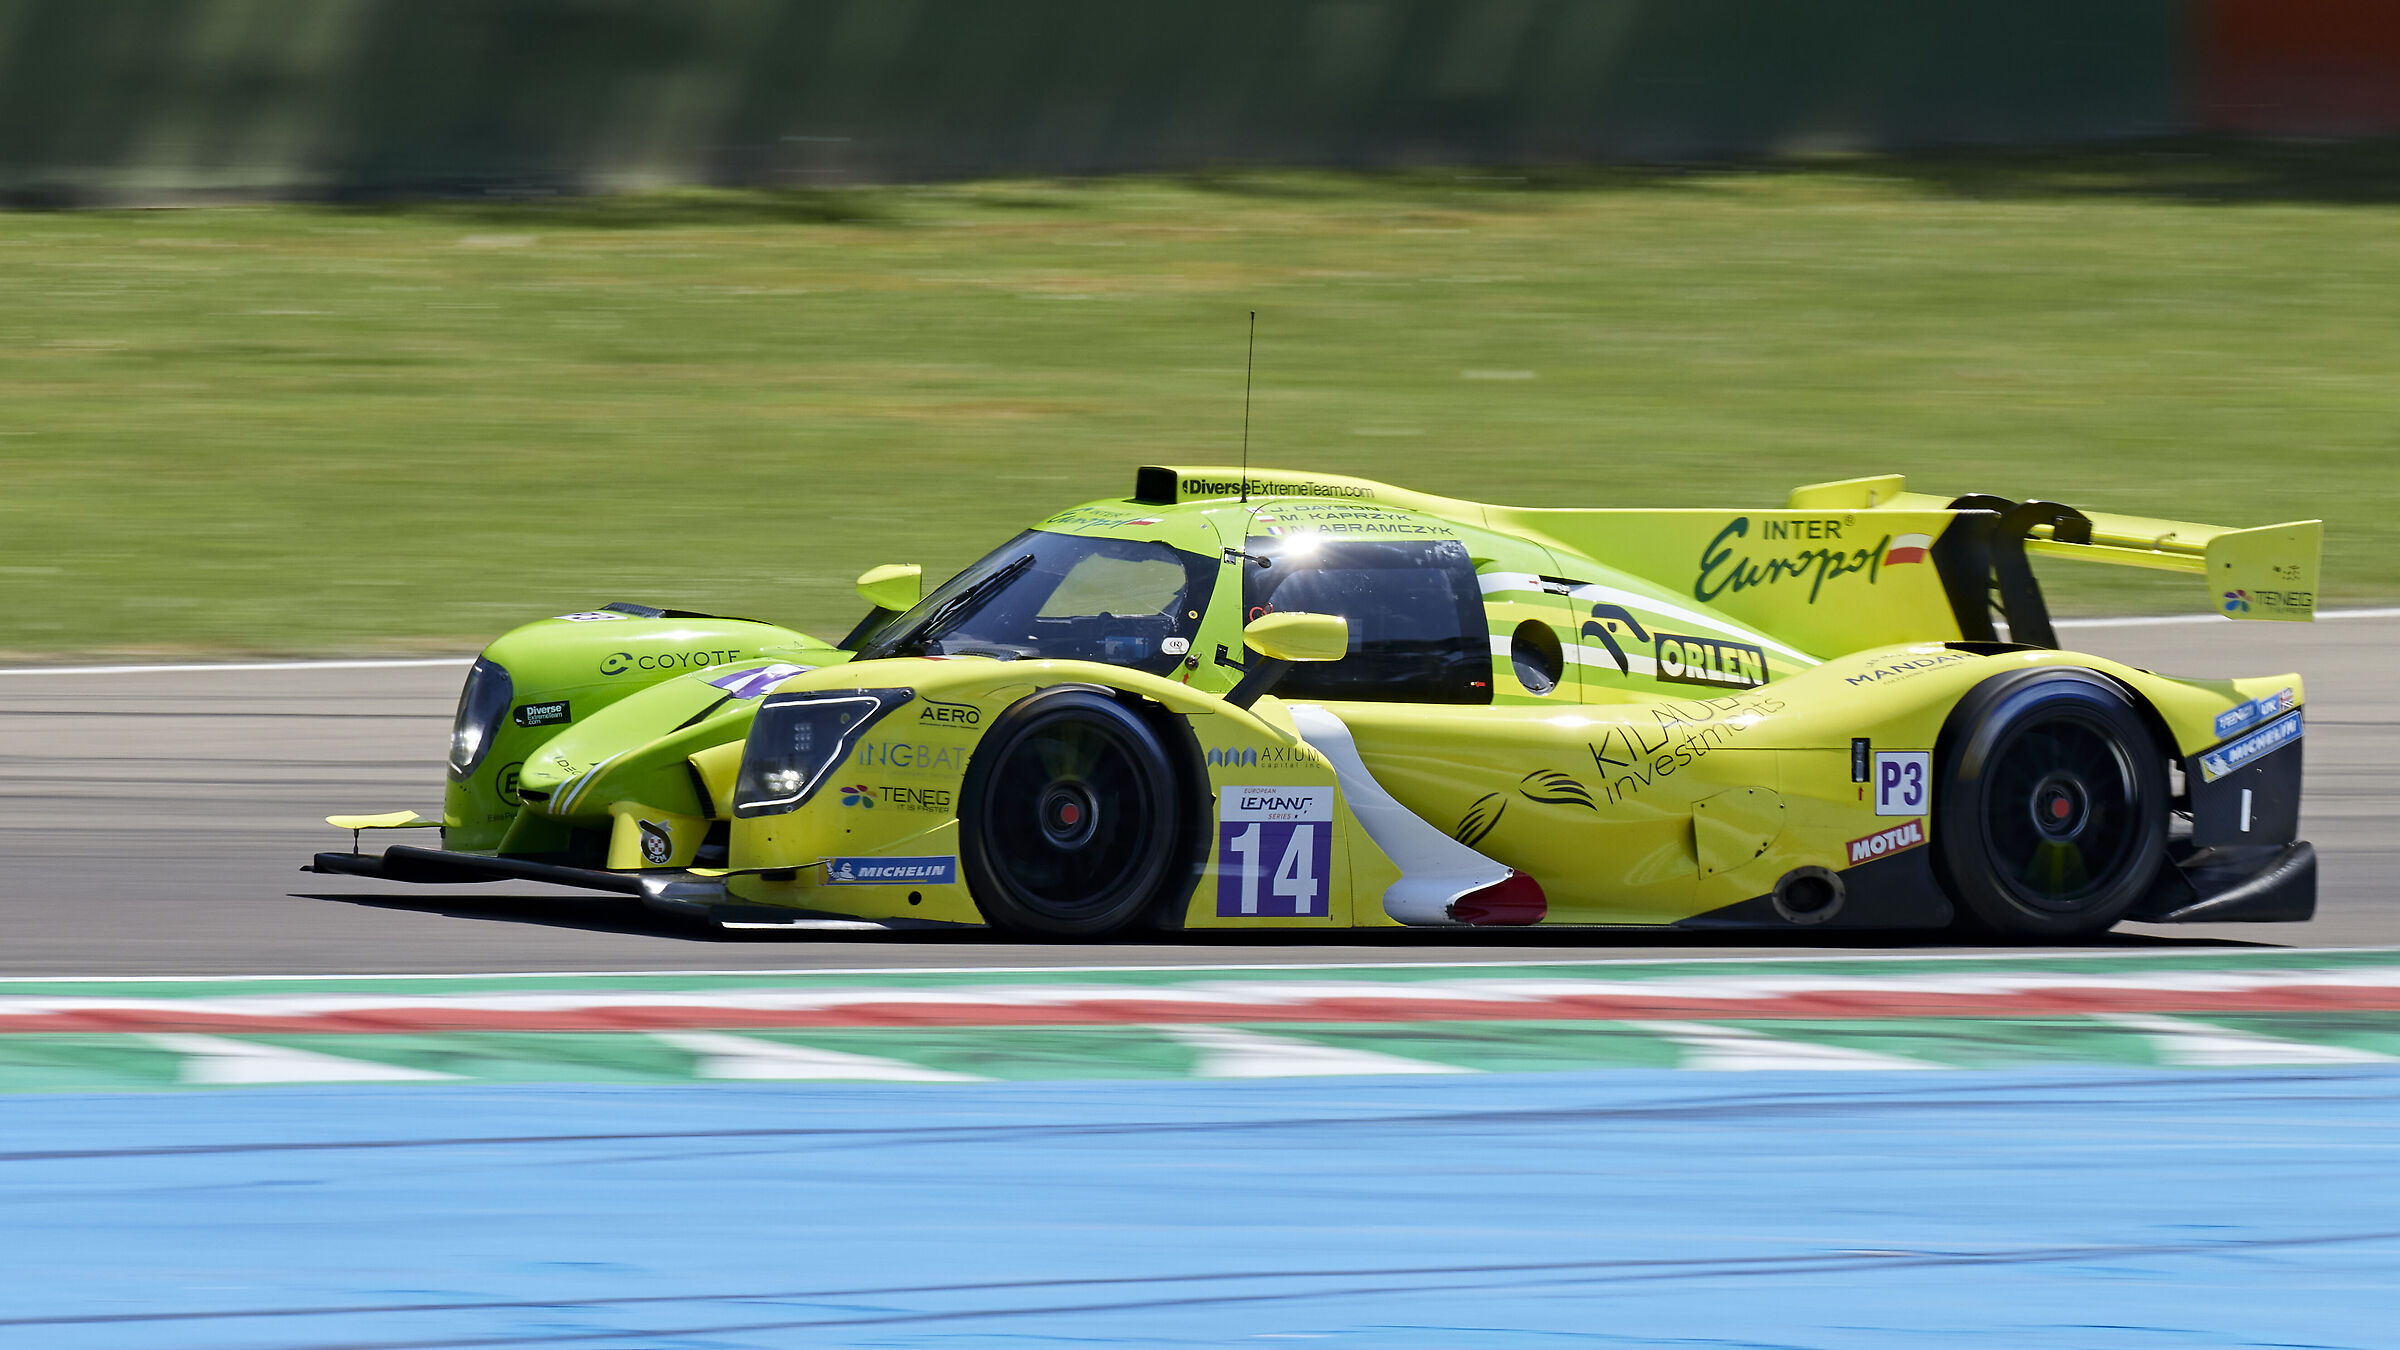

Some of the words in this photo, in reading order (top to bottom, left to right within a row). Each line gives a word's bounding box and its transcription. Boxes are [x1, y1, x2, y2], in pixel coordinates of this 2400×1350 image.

[1309, 513, 1411, 521] KAPRZYK
[1319, 523, 1454, 536] ABRAMCZYK
[1763, 520, 1842, 539] INTER
[1695, 517, 1892, 604] Europol
[1660, 639, 1765, 686] ORLEN
[1845, 653, 1978, 686] MANDA
[526, 705, 562, 715] Diverse
[920, 706, 980, 724] AERO
[1589, 693, 1762, 779] KILAUE
[1606, 697, 1786, 805] investments
[2229, 718, 2297, 762] MICHELIN
[1261, 747, 1320, 761] AXIUM
[879, 786, 950, 806] TENEG
[1881, 761, 1924, 806] P3
[1852, 823, 1922, 862] MOTUL
[858, 865, 946, 877] MICHELIN
[1231, 822, 1318, 914] 14
